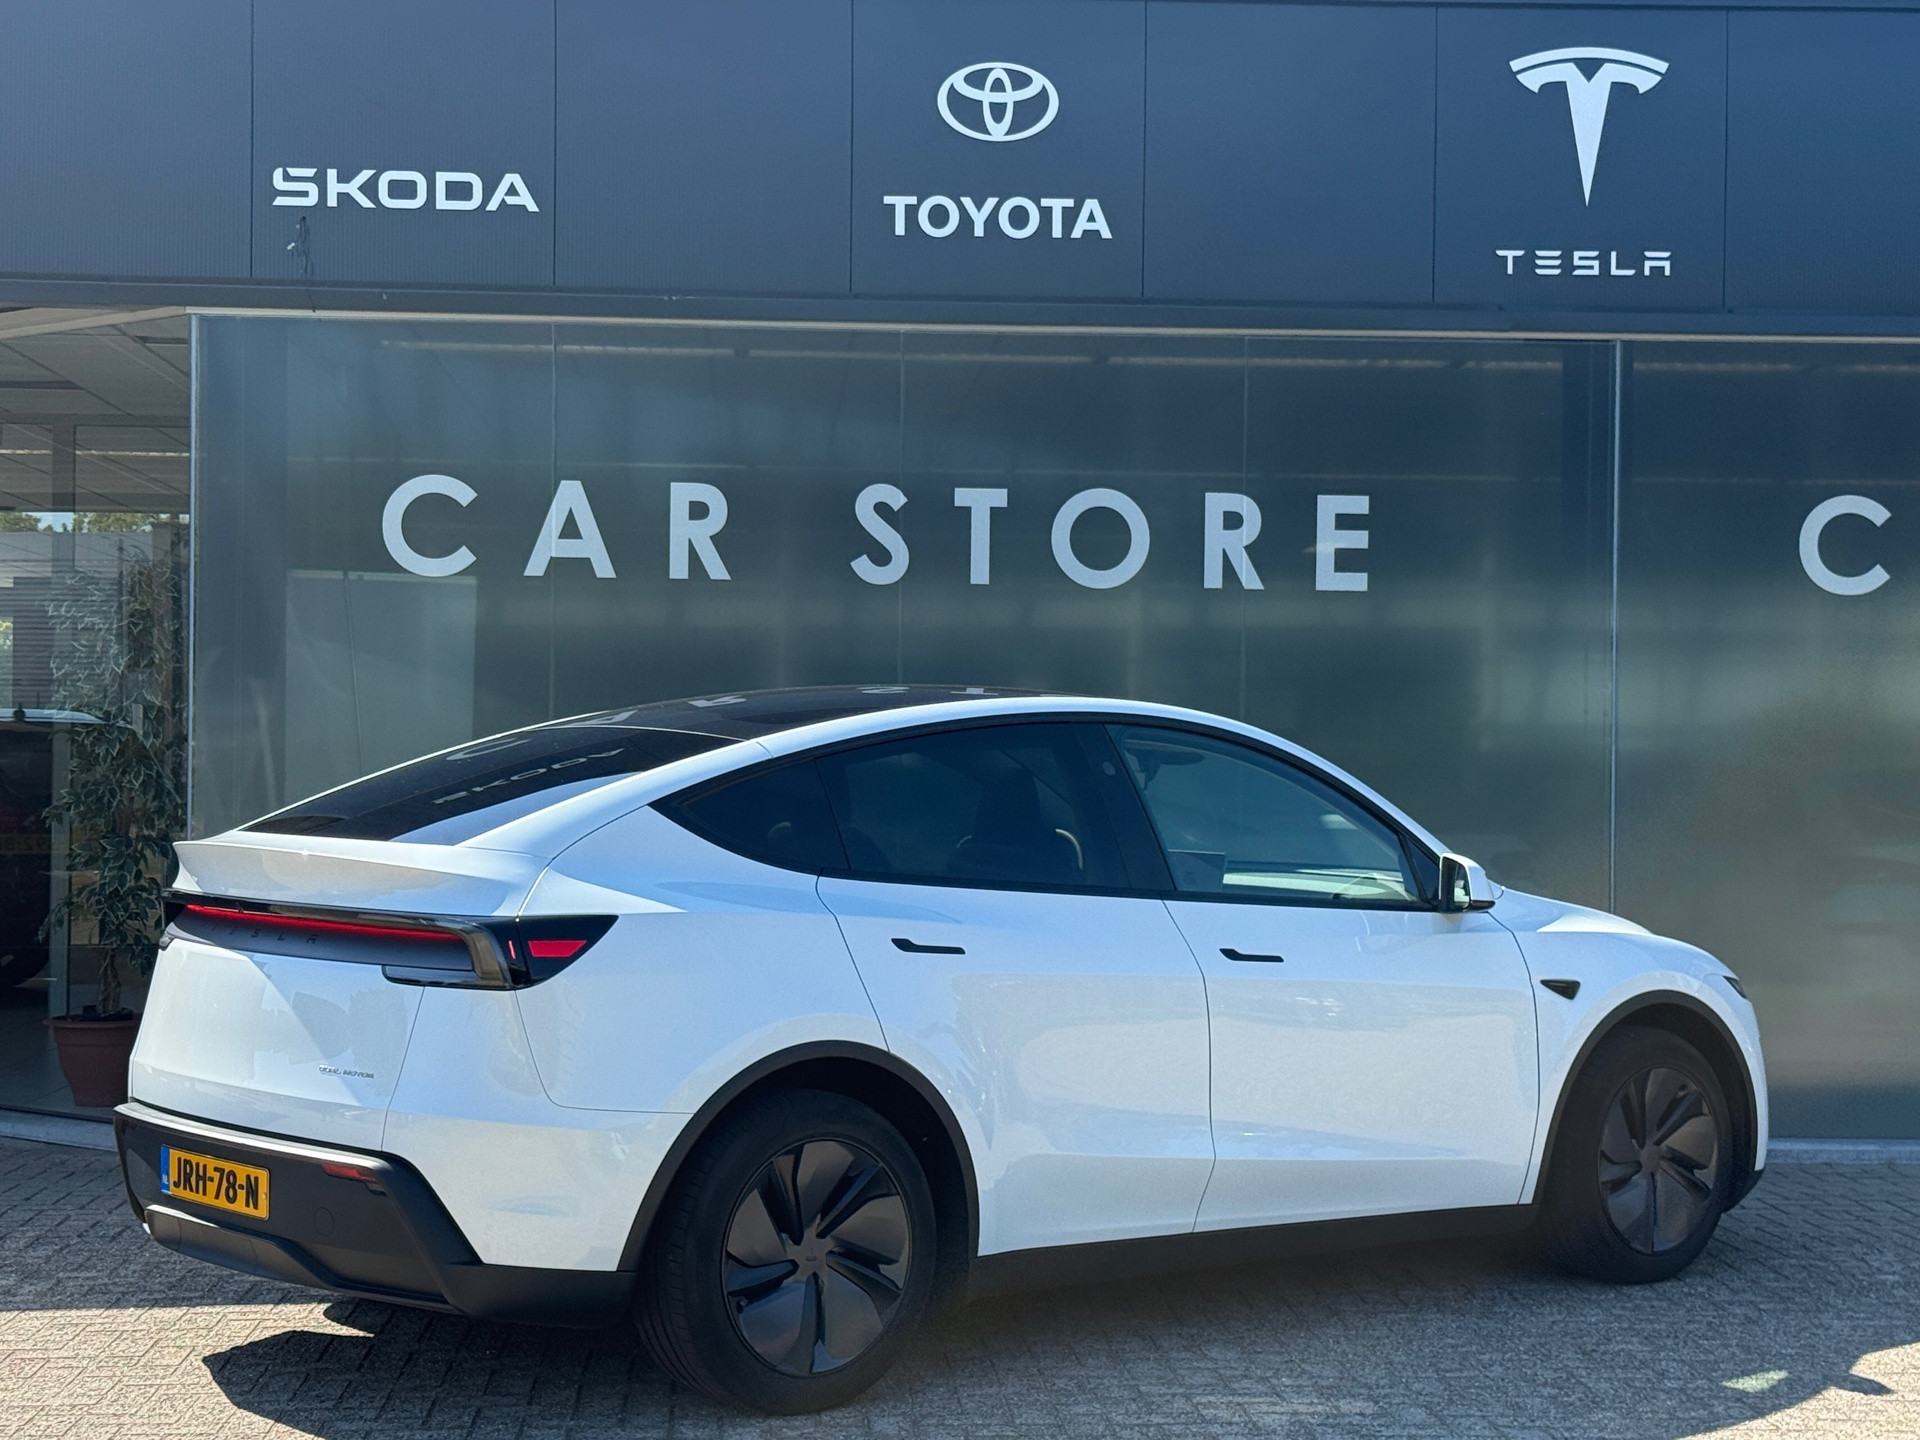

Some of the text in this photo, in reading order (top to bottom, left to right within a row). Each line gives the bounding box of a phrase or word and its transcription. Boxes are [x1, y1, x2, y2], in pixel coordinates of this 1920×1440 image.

[883, 195, 1113, 239] TOYOTA
[1495, 250, 1672, 276] TESLA
[381, 474, 1370, 592] CAR STORE
[1799, 494, 1892, 596] C
[173, 1157, 259, 1210] JRH-78-N
